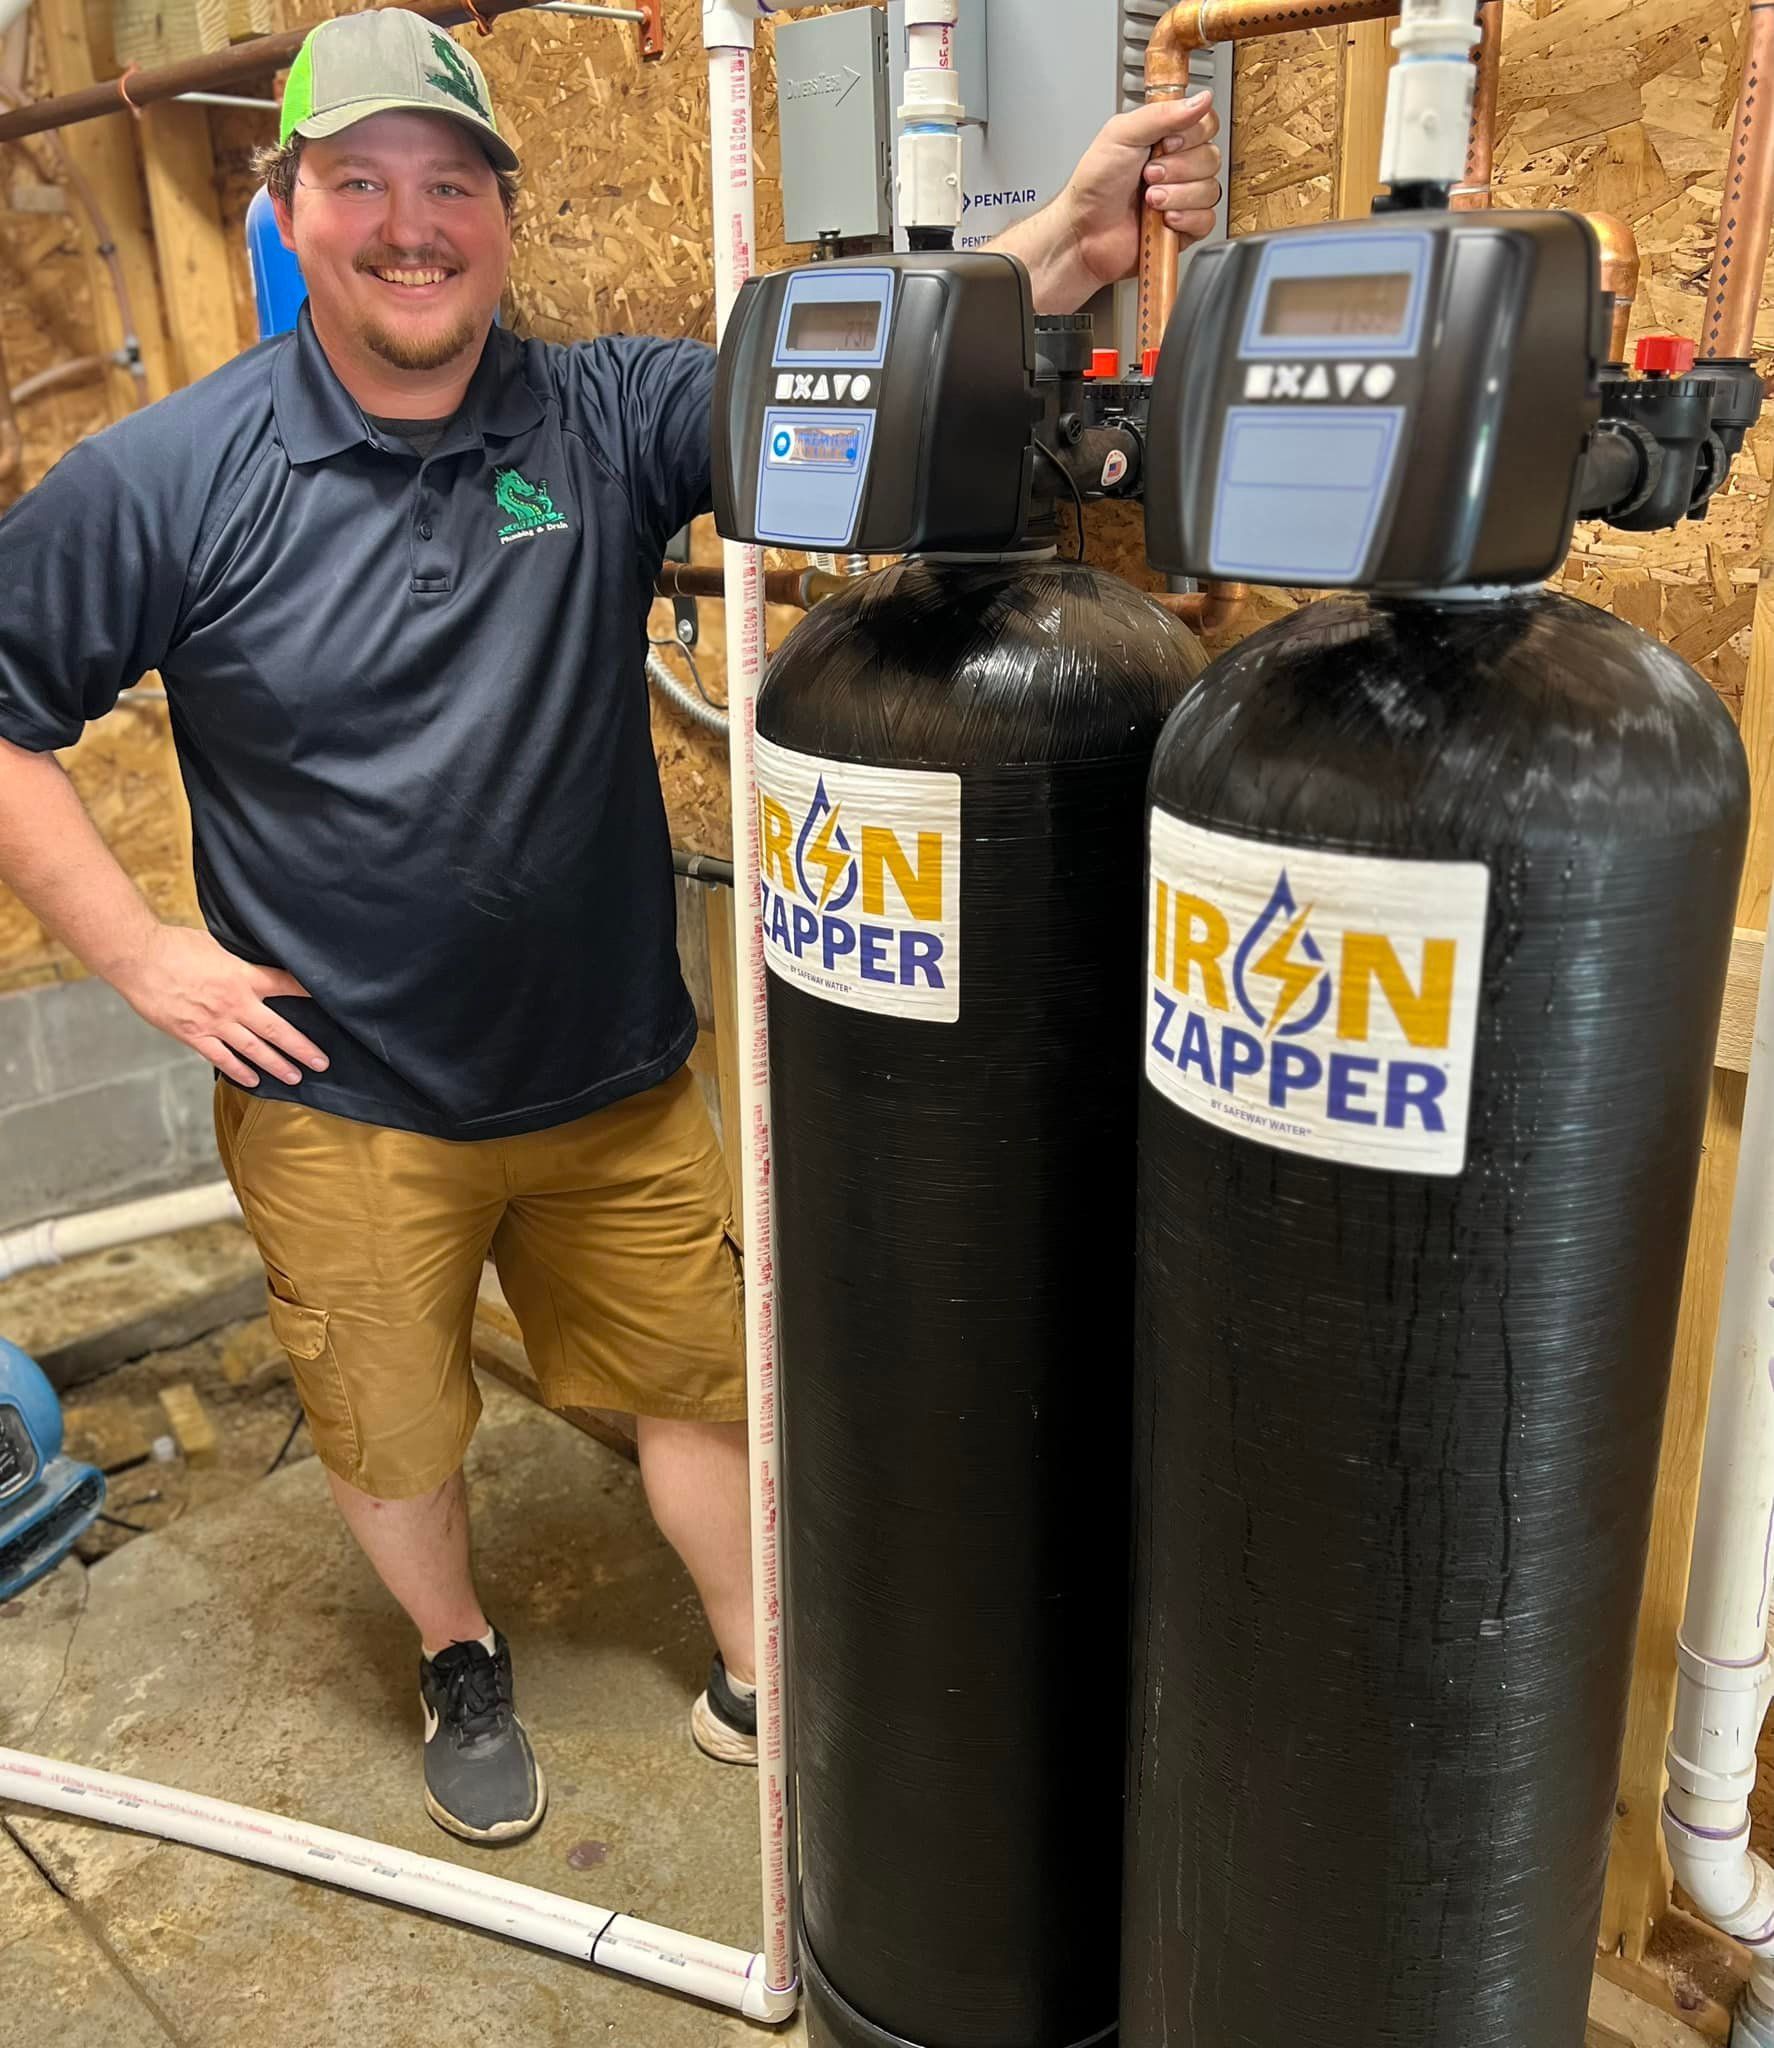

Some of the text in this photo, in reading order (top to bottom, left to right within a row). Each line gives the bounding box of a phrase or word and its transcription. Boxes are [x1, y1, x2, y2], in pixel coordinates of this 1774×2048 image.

[974, 189, 1036, 208] PENTAIR
[1154, 866, 1457, 1050] IRON
[797, 967, 825, 985] SAFEWAY
[1223, 1104, 1268, 1126] SAFEWAY
